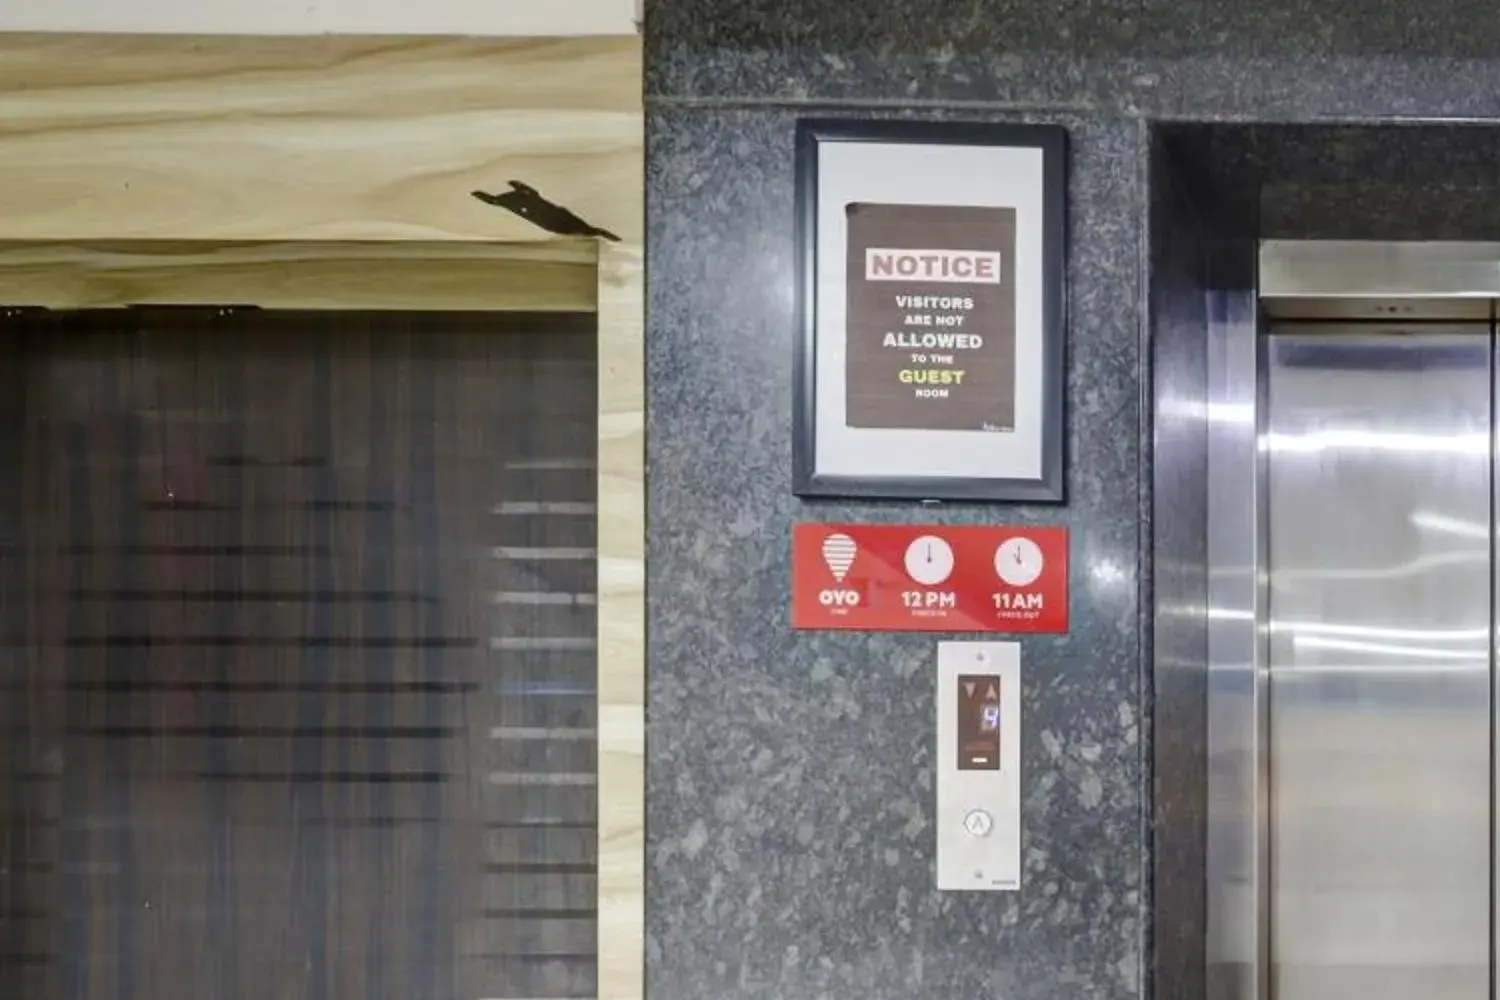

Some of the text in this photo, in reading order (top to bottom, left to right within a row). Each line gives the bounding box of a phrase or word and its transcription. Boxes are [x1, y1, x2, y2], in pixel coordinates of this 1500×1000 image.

[873, 255, 993, 278] NOTICE
[896, 296, 974, 309] VISITORS
[904, 316, 963, 326] ARE NOT
[883, 333, 982, 348] ALLOWED
[911, 354, 953, 364] TO THE
[899, 370, 965, 384] GUEST
[819, 590, 860, 605] OYO
[901, 591, 956, 608] 12 PM
